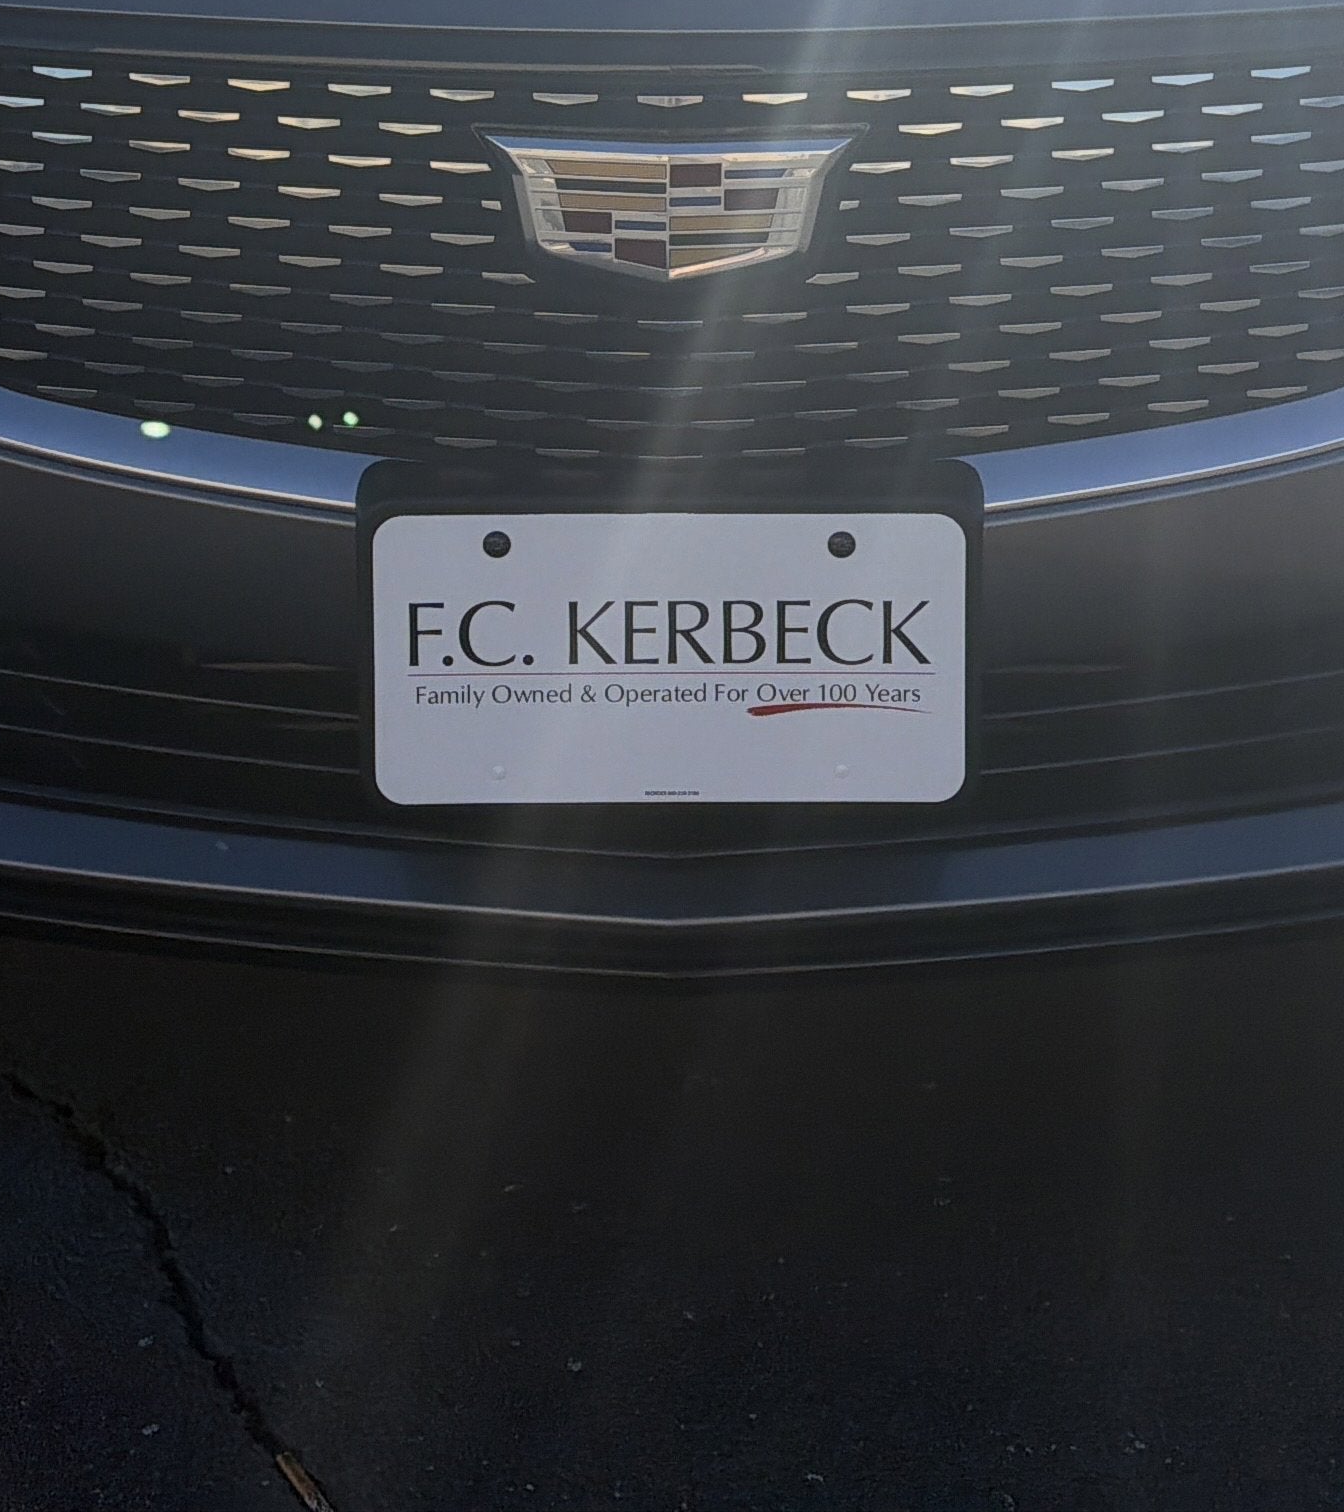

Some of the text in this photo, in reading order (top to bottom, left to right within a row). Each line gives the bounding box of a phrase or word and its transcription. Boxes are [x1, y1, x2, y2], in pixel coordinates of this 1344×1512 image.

[408, 599, 932, 667] F.C. KERBECK
[415, 683, 921, 709] Family Owned & Operated For Over 100 Years
